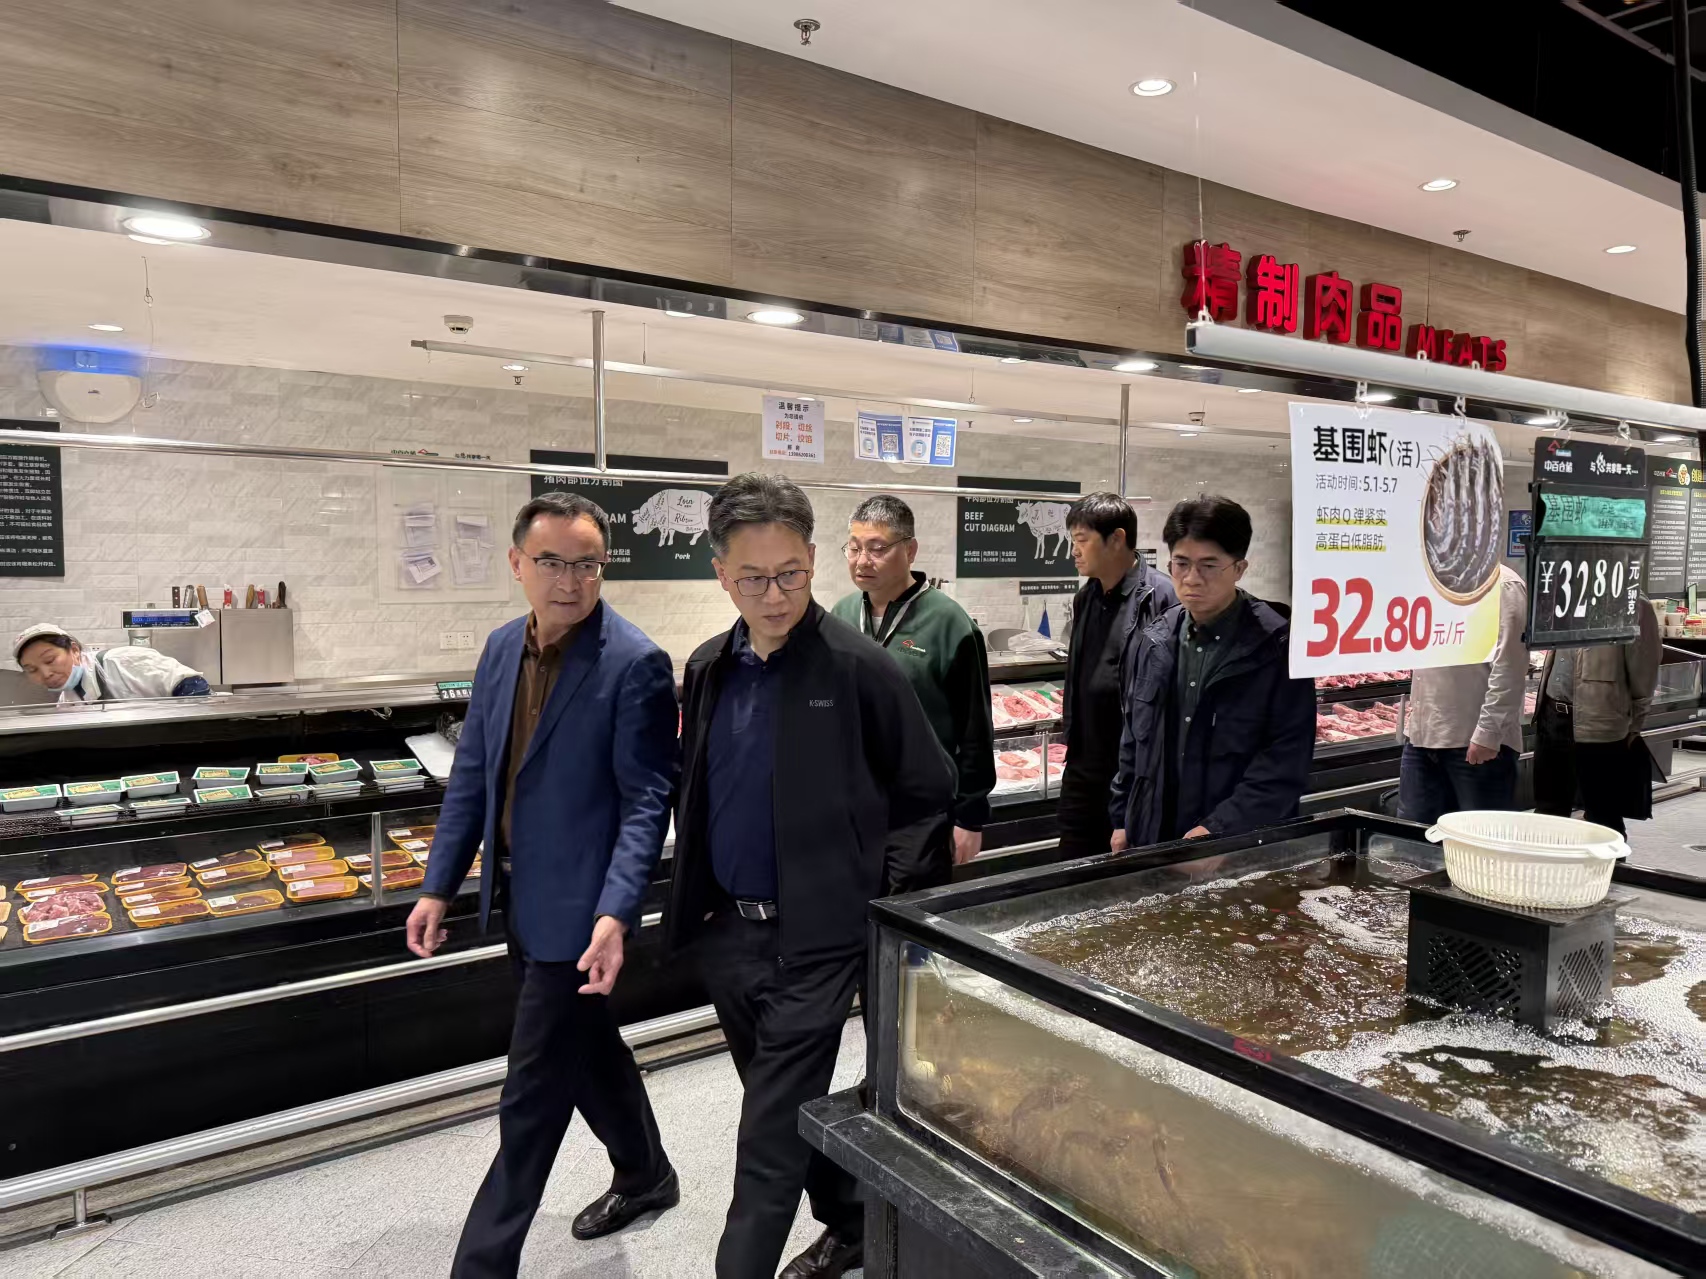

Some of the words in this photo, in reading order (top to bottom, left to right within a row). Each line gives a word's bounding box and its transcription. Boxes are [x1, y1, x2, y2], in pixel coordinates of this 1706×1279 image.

[1181, 239, 1402, 351] 精制肉品
[1406, 324, 1507, 371] MEATS
[778, 401, 809, 412] 温馨提示
[1313, 425, 1421, 469] 基围虾(活)
[1544, 460, 1573, 473] 中百仓储
[964, 511, 984, 521] BEEF
[964, 522, 980, 532] CUT
[981, 523, 1015, 533] DIAGRAM
[1315, 532, 1385, 551] 高蛋白低脂肪
[674, 552, 691, 560] Pork
[1306, 577, 1432, 657] 32.80
[1432, 621, 1465, 647] 元/斤
